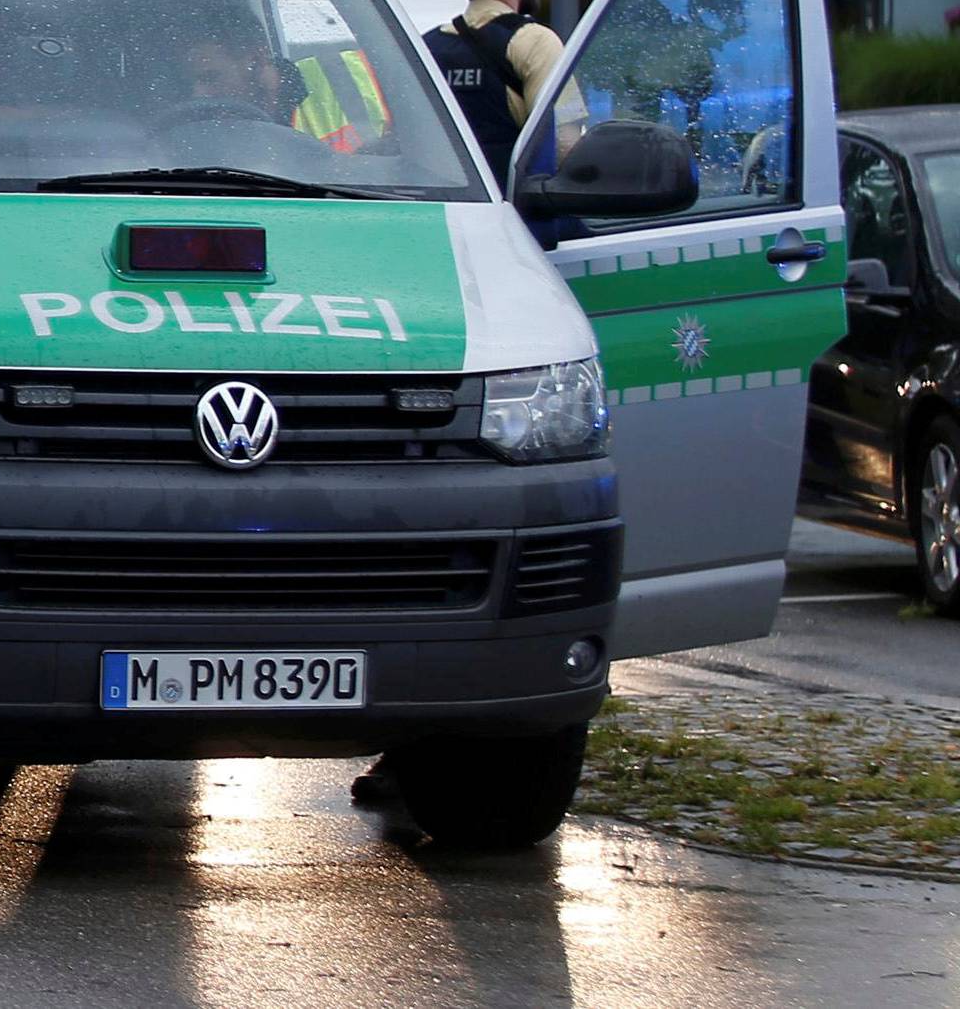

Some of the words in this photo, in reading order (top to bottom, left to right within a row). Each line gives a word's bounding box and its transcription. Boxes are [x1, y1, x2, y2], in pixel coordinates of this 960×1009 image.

[447, 69, 482, 86] IZEI
[19, 290, 408, 342] POLIZEI
[197, 381, 278, 469] VW
[110, 686, 120, 698] D
[131, 658, 159, 701] M
[188, 658, 244, 701] PM
[253, 658, 357, 700] 8390
